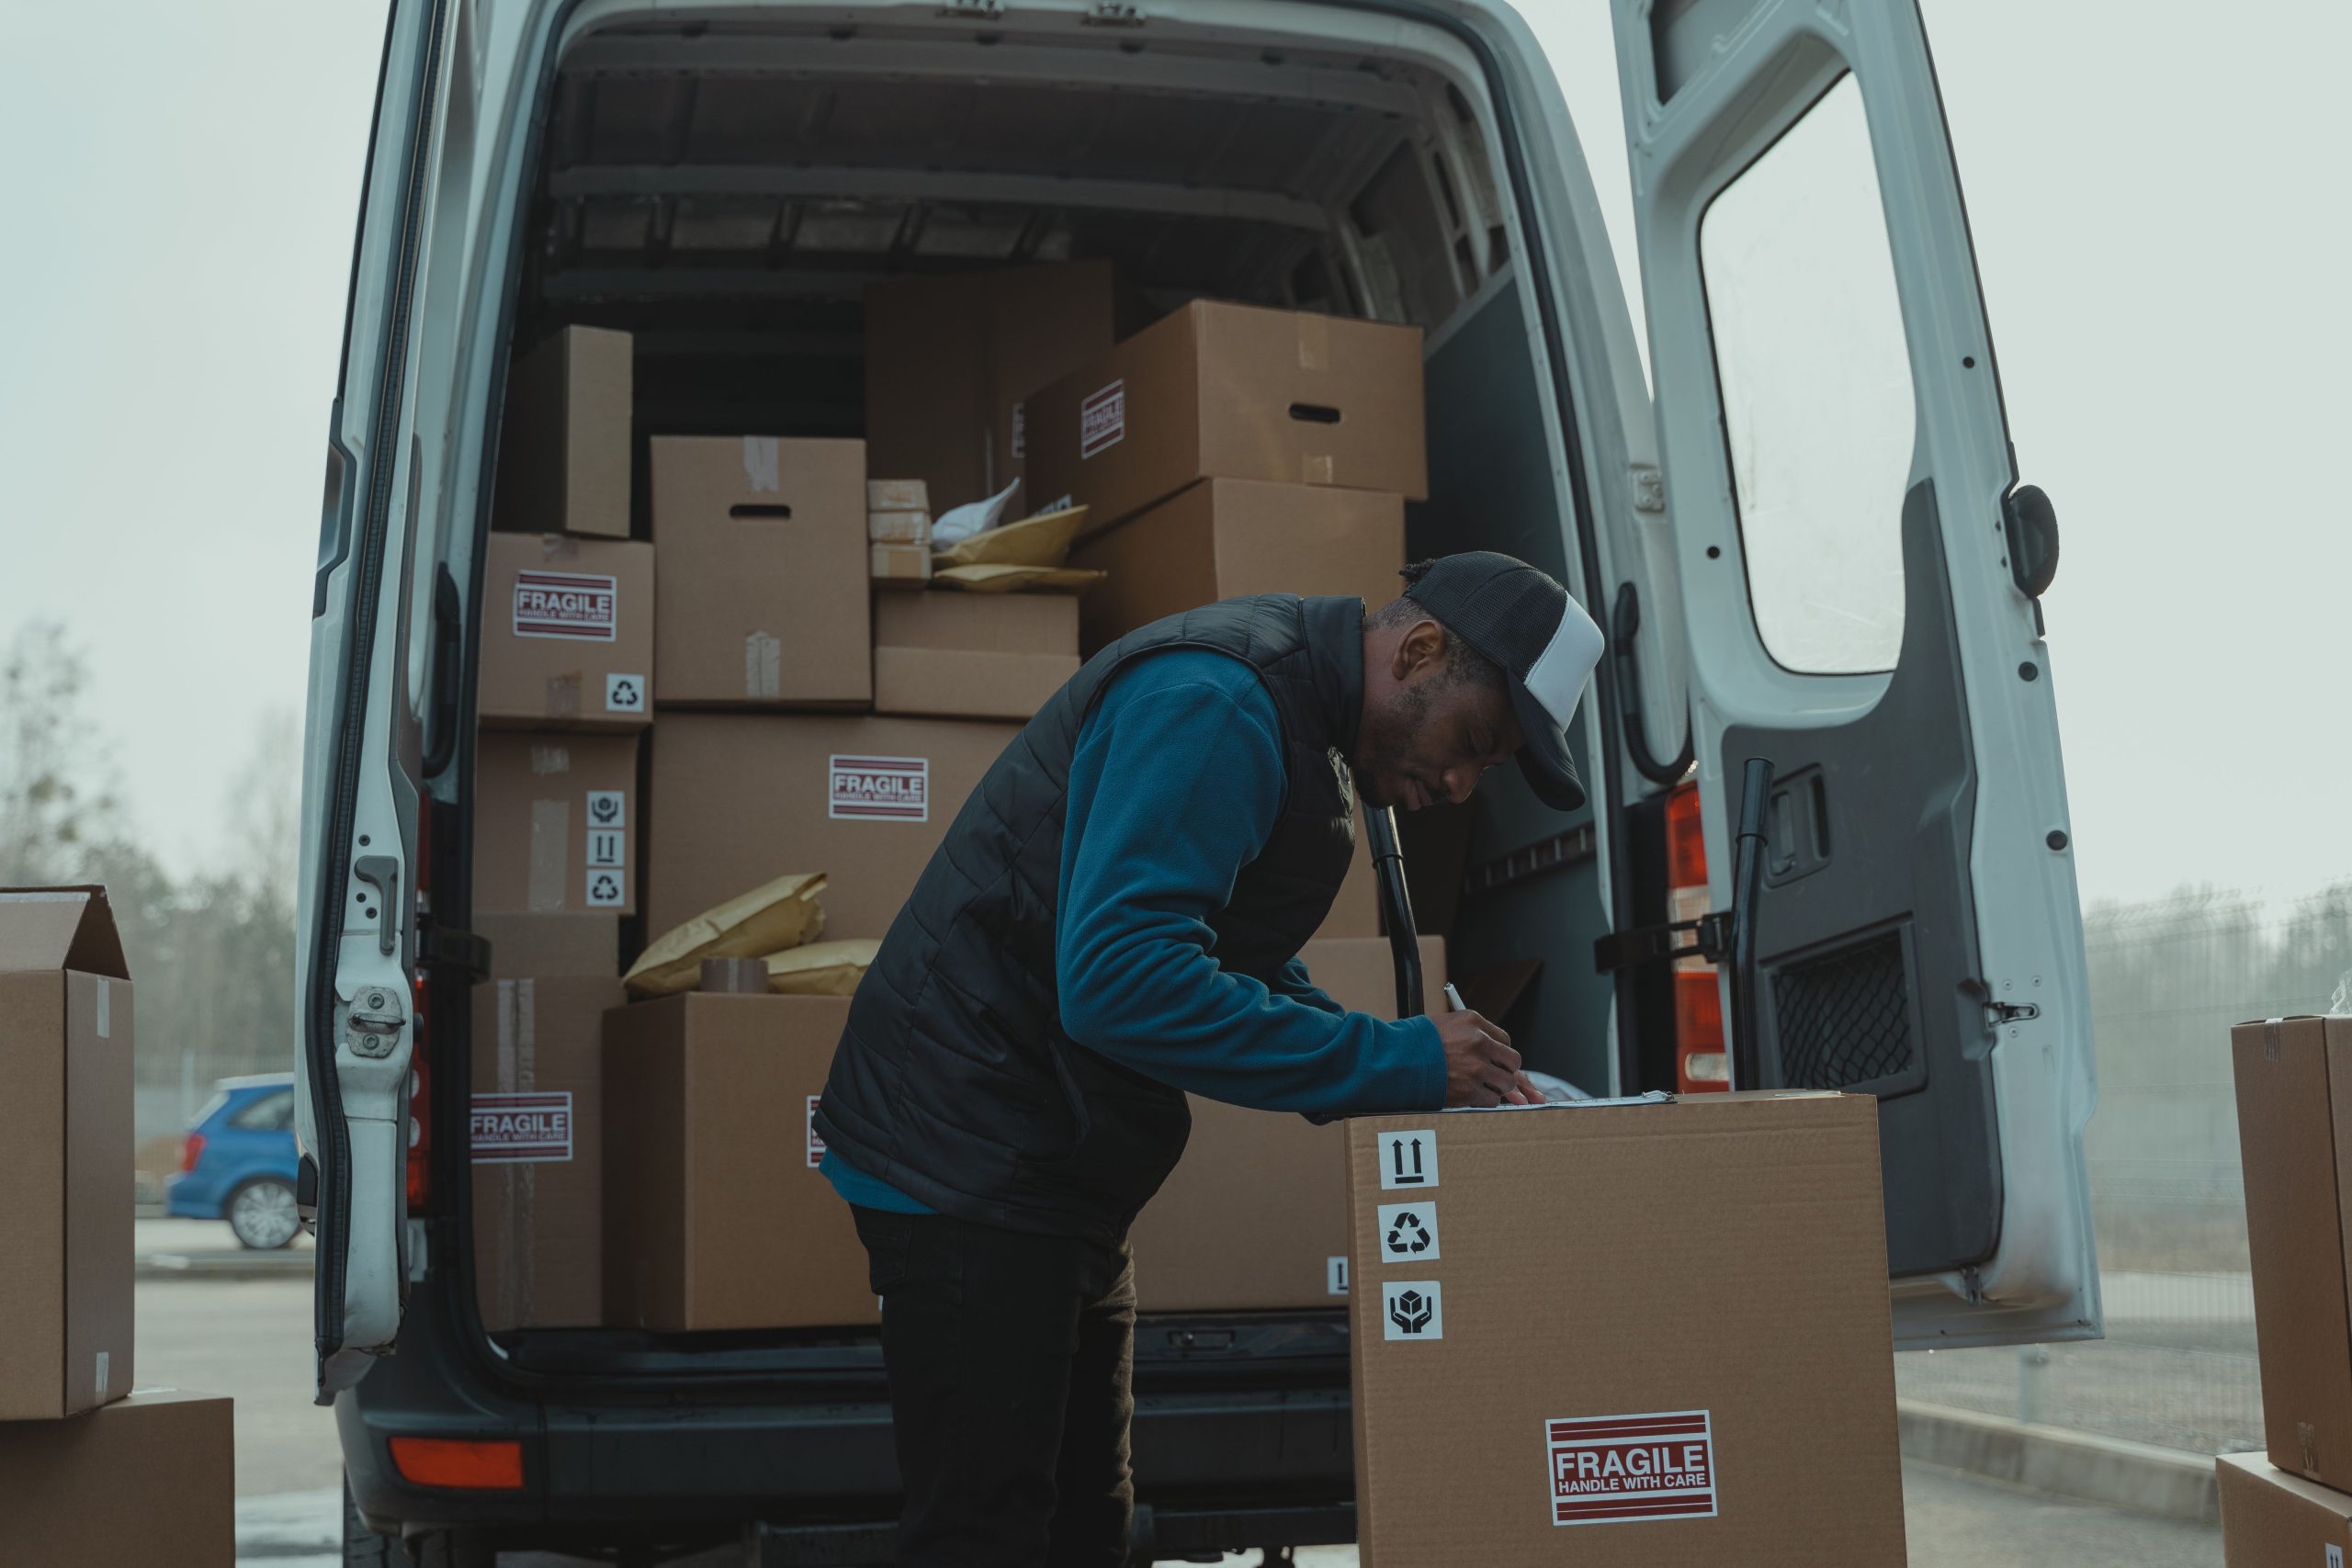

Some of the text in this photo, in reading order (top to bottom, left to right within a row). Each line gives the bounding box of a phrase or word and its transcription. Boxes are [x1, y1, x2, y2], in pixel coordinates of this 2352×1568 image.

[518, 591, 611, 613] FRAGILE
[834, 774, 923, 796] FRAGILE
[470, 1113, 566, 1134] FRAGILE
[1555, 1445, 1705, 1480] FRAGILE
[1559, 1472, 1706, 1494] HANDLE WITH CARE
